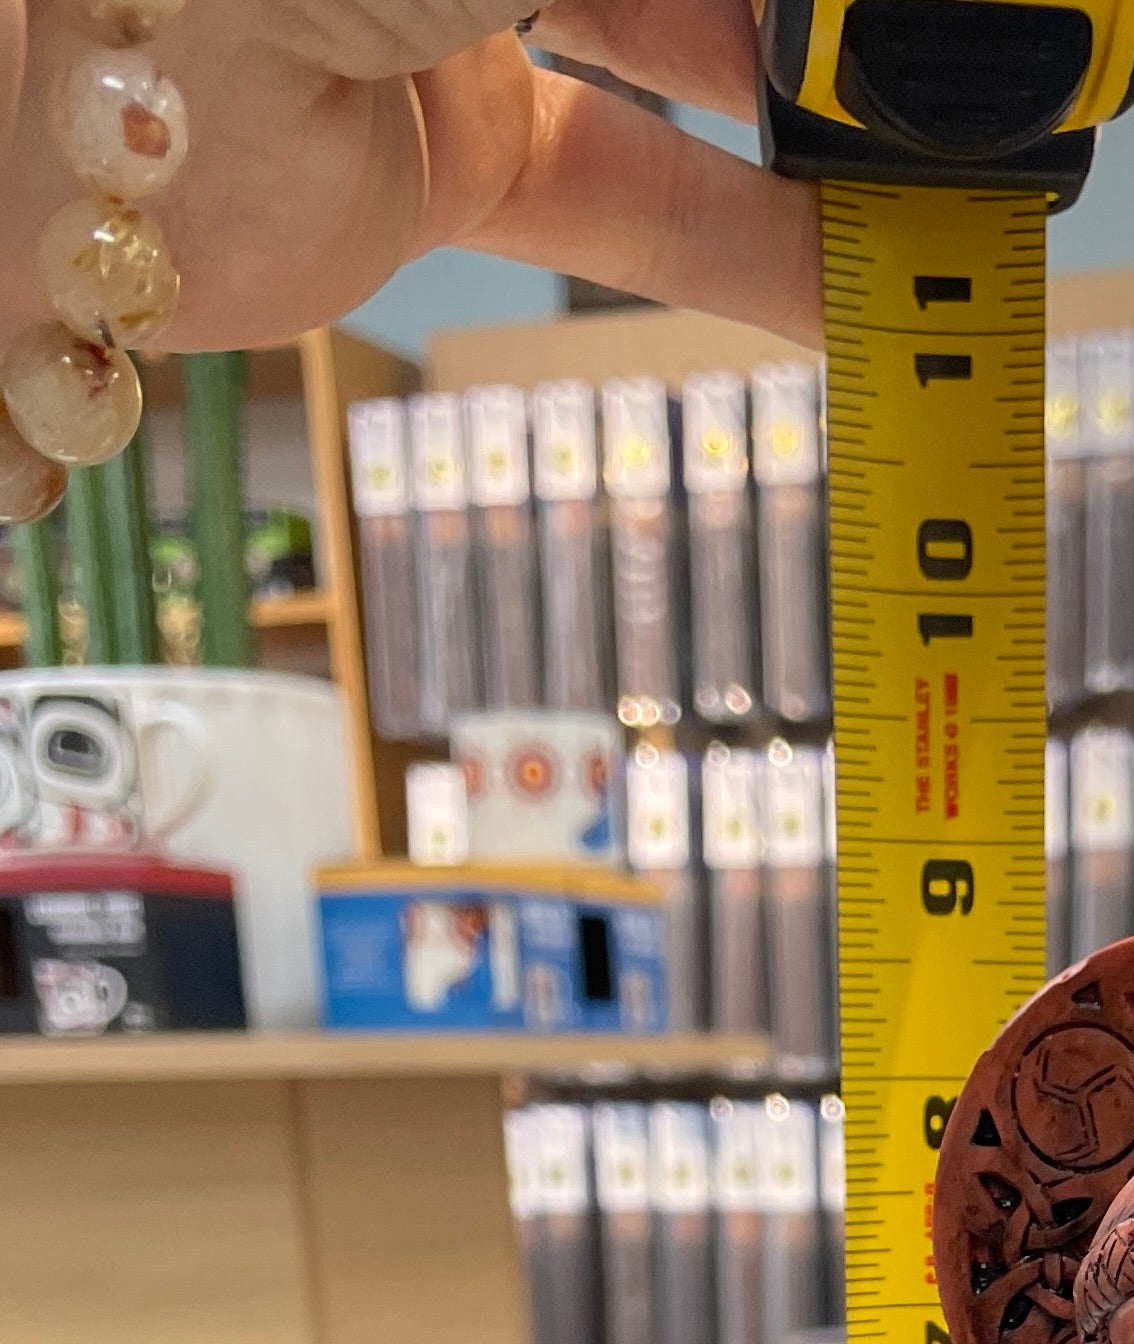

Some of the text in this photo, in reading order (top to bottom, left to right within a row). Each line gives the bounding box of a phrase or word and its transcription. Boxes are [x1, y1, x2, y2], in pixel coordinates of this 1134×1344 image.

[915, 517, 975, 646] 10
[916, 676, 931, 812] THE STANLEY
[944, 743, 959, 821] WORKS
[920, 858, 975, 916] 9
